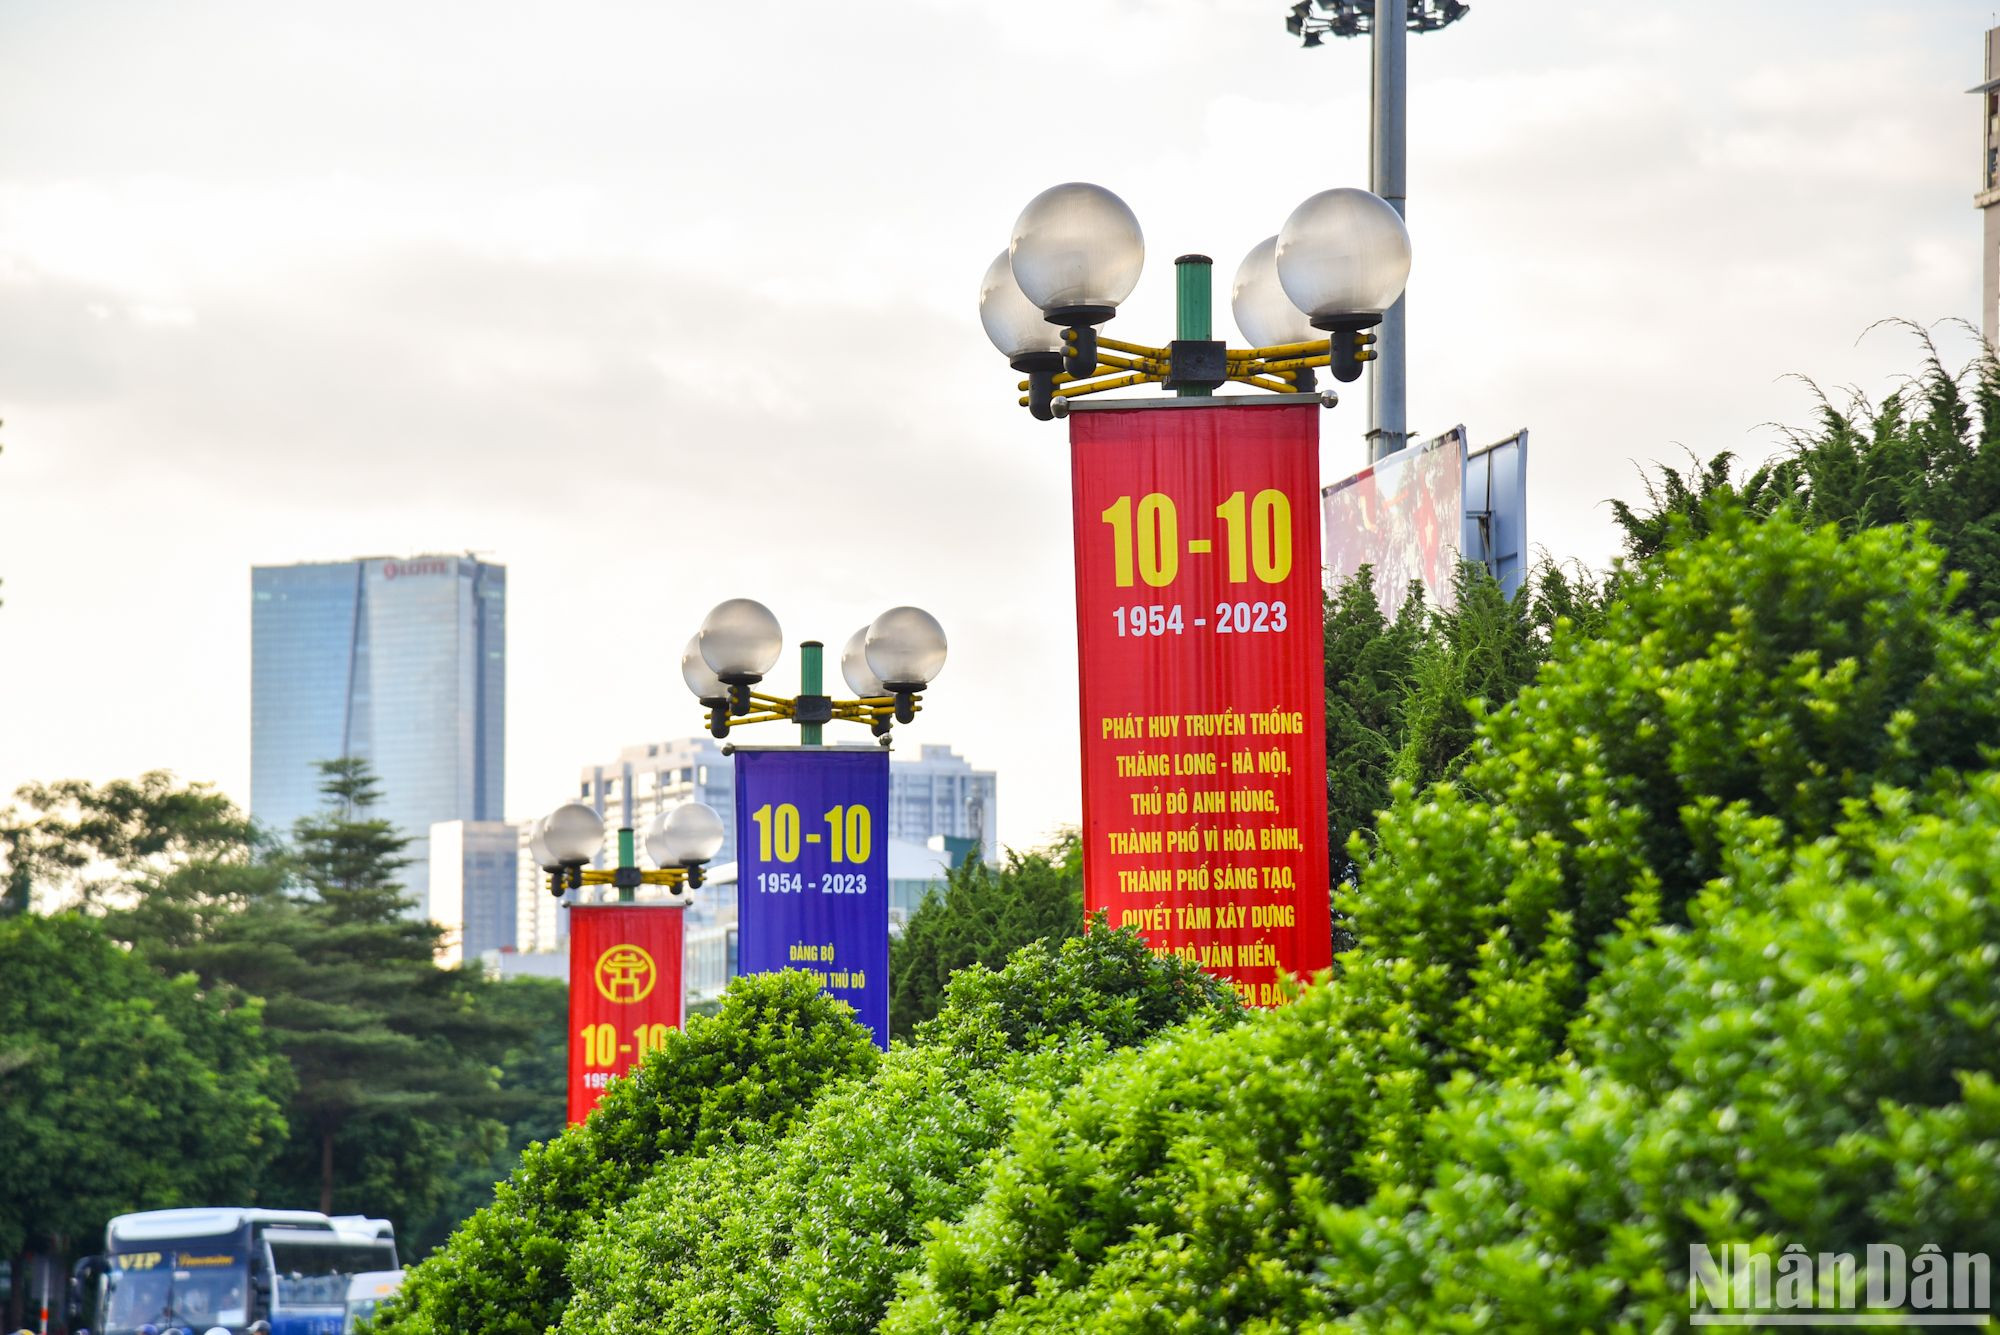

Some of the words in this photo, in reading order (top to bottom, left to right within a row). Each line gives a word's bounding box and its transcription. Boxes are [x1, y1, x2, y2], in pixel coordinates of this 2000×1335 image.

[1113, 604, 1184, 637] 1954
[1216, 601, 1287, 633] 2023
[1102, 712, 1143, 740] PHÁT
[1149, 715, 1180, 738] HUY
[1185, 707, 1246, 737] TRUYỀN
[1250, 704, 1303, 735] THỐNG
[1116, 750, 1169, 777] THĂNG
[1175, 753, 1217, 775] LONG
[1232, 747, 1254, 774] HÀ
[1259, 747, 1291, 778] NỘI,
[1131, 786, 1161, 815] THỦ
[1166, 787, 1188, 814] ĐÔ
[1193, 791, 1225, 813] ANH
[1230, 785, 1280, 814] HÙNG,
[1109, 828, 1162, 854] THÀNH
[1167, 823, 1199, 853] PHỐ
[1204, 825, 1218, 851] VÌ
[1224, 824, 1256, 851] HÒA
[1261, 823, 1304, 853] BÌNH,
[758, 872, 802, 893] 1954
[822, 873, 867, 894] 2023
[1119, 866, 1171, 892] THÀNH
[1177, 861, 1209, 891] PHỐ
[1214, 863, 1258, 890] SÁNG
[1262, 866, 1296, 894] TẠO,
[1176, 903, 1211, 929] TÂM
[1216, 902, 1246, 928] XÂY
[1252, 903, 1295, 933] DỰNG
[789, 940, 818, 961] ĐẢNG
[820, 942, 835, 965] BỘ
[1200, 941, 1233, 967] VĂN
[1238, 937, 1281, 969] HIẾN,
[830, 967, 849, 989] THỦ
[851, 969, 866, 989] ĐÔ
[118, 1251, 162, 1271] VIP
